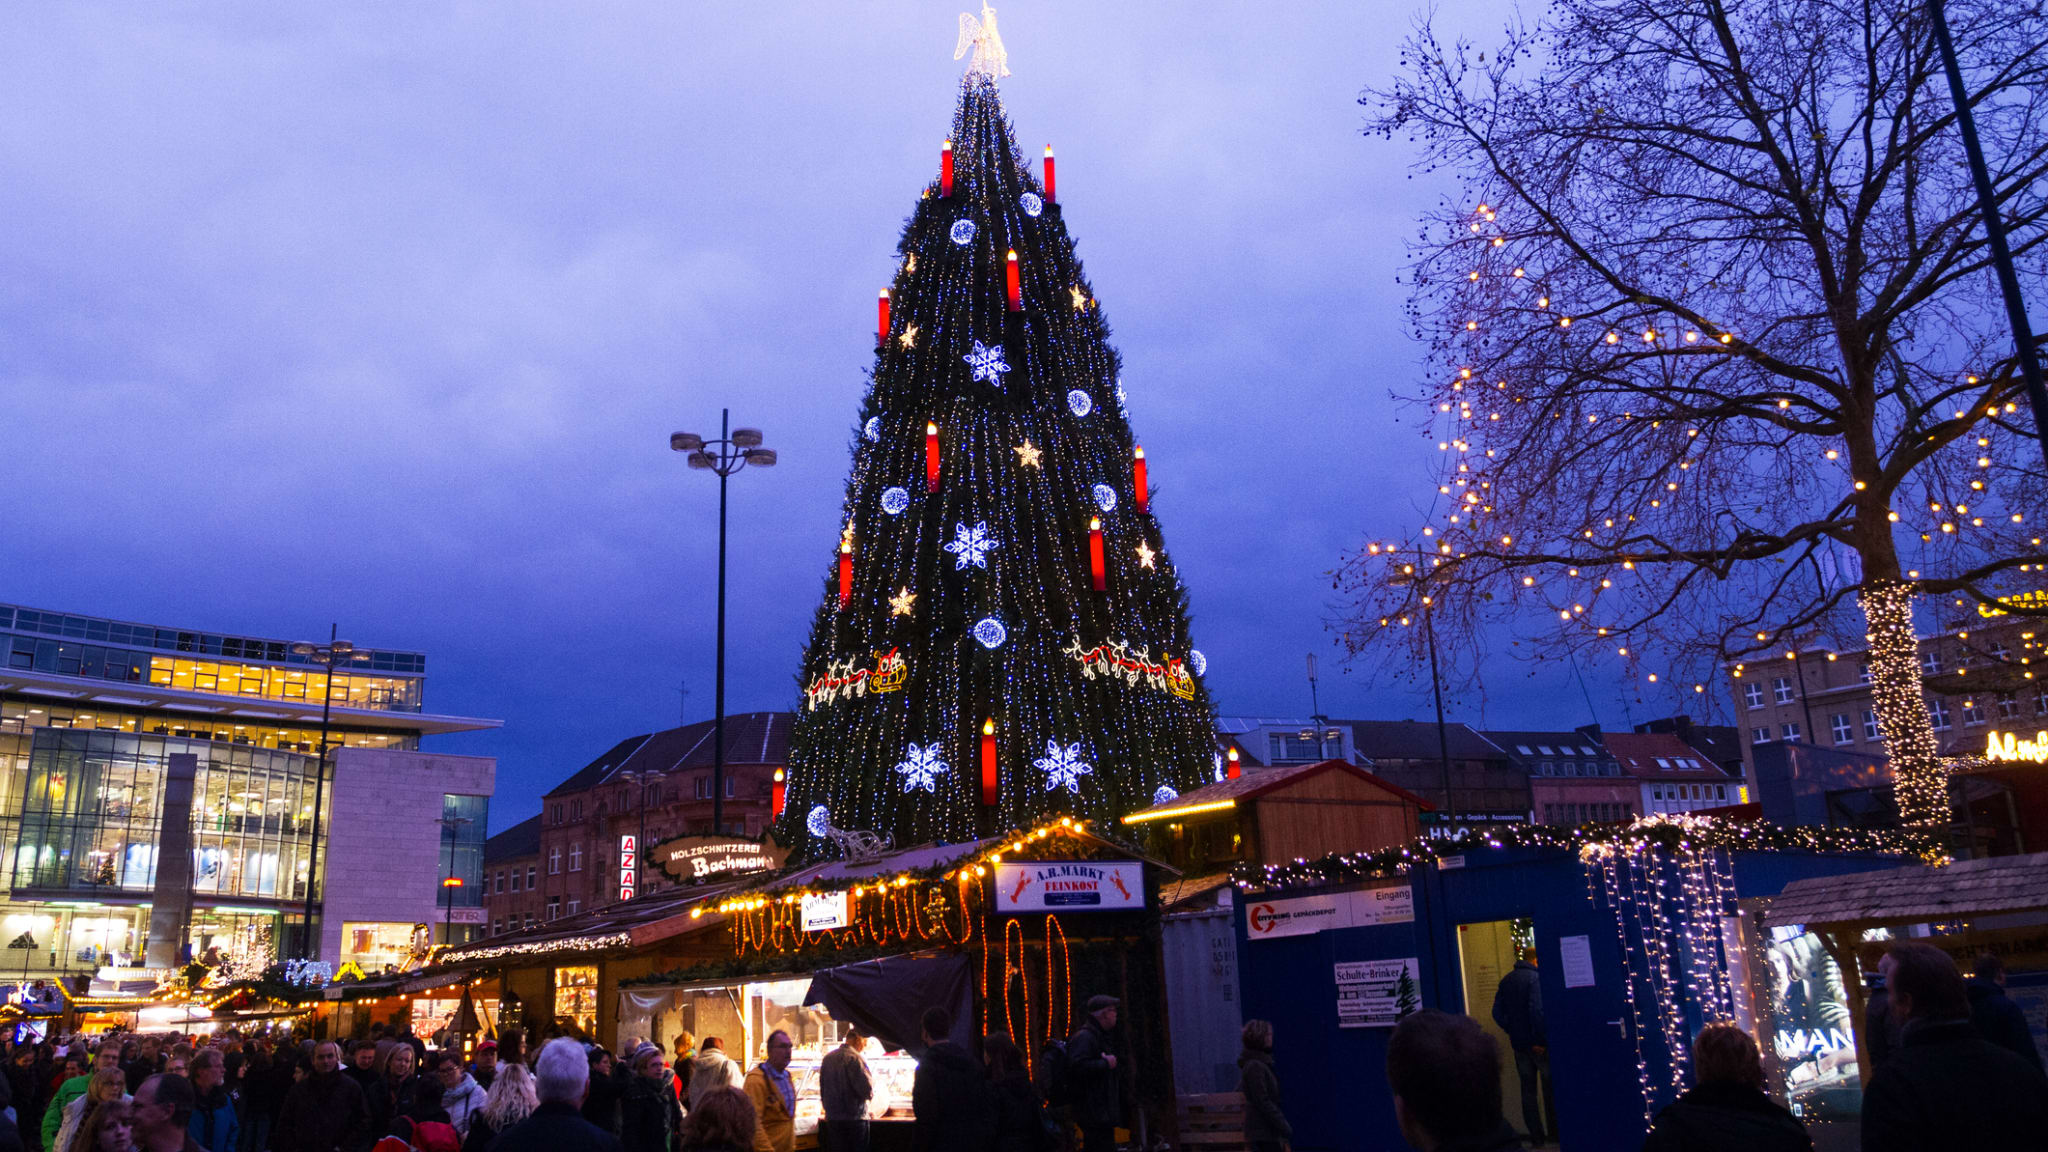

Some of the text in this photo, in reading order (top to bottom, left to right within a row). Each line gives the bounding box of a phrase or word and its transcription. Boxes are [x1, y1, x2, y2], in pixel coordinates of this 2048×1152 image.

[1440, 813, 1463, 821] Tasen
[670, 843, 761, 861] HOLZSCHNITZEREI
[1045, 881, 1099, 892] FEINKOST
[1376, 890, 1411, 901] Eingang
[1336, 967, 1400, 981] Schulte-Brinker
